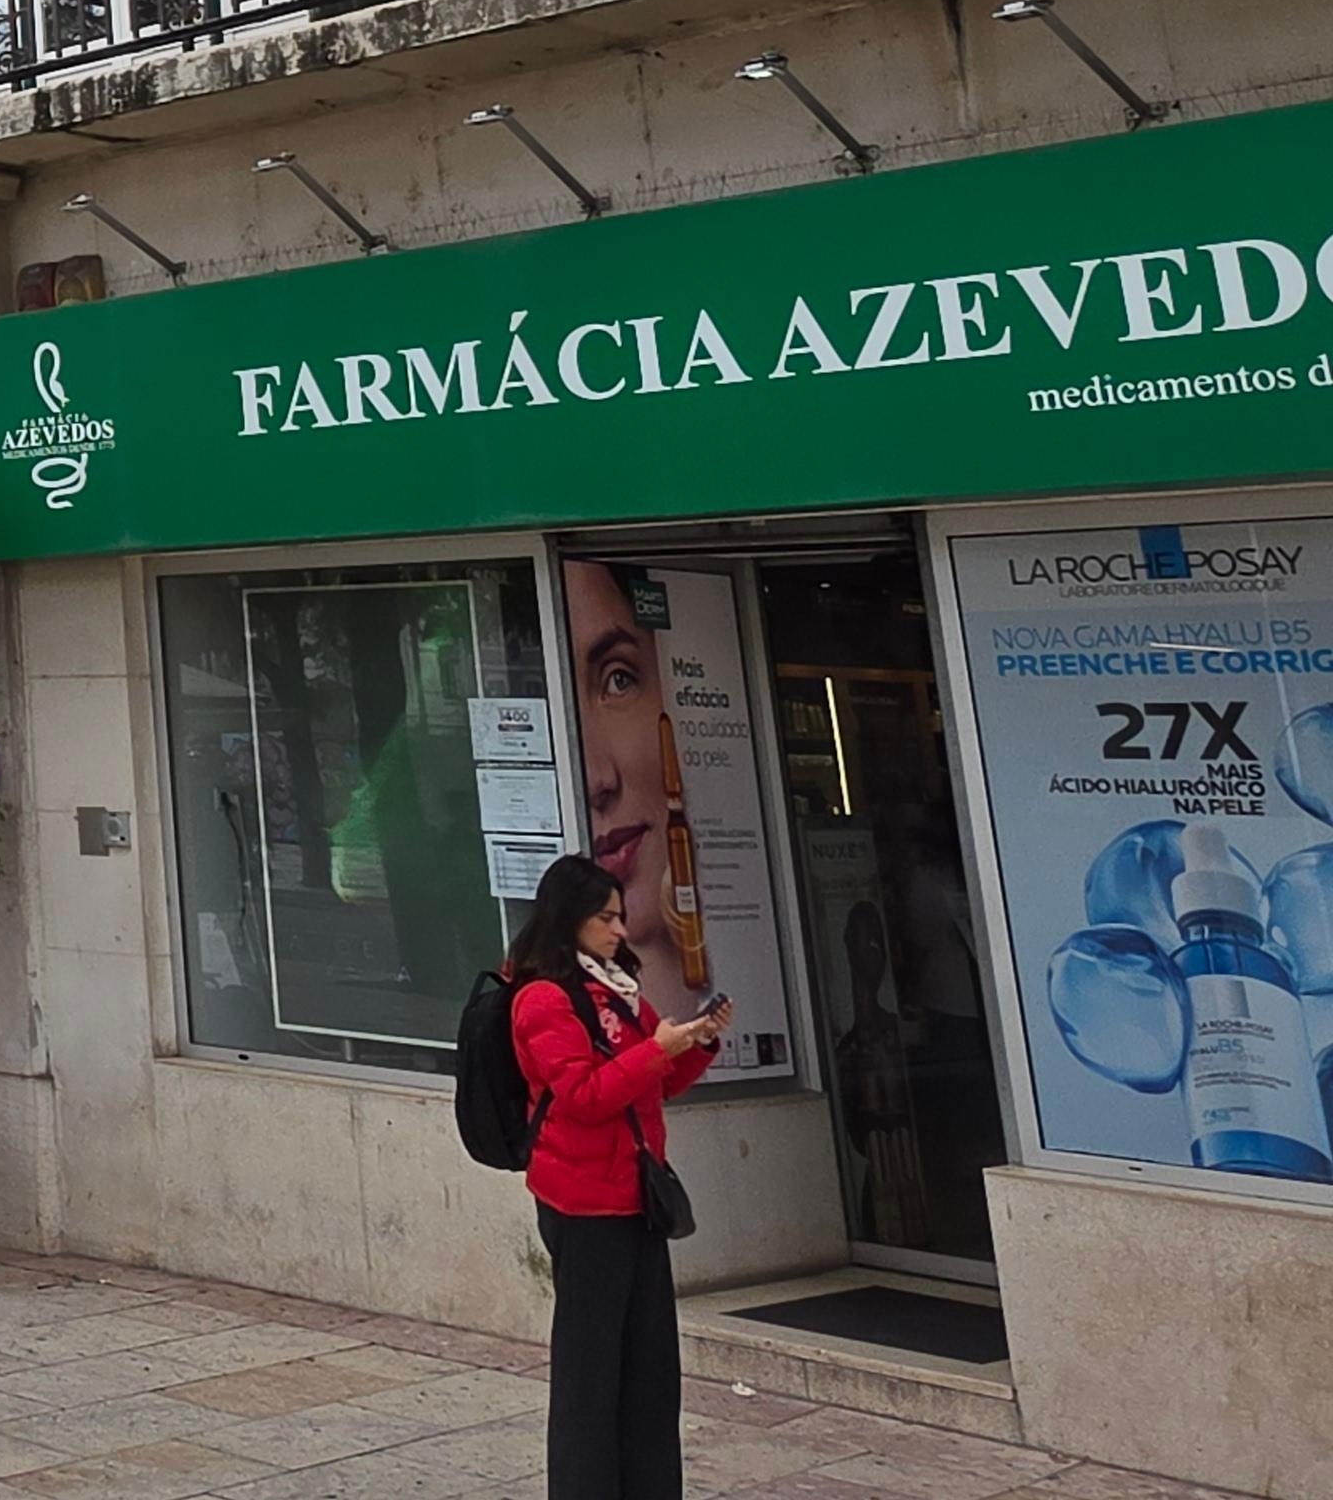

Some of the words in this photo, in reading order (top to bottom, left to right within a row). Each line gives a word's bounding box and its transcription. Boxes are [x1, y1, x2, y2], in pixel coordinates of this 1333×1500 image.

[233, 310, 753, 437] FARMÁCIA
[768, 235, 1333, 380] AZEVED
[1028, 364, 1297, 412] medicamentos
[1, 419, 115, 450] AZEVEDOS
[1008, 558, 1053, 586] LA
[1054, 550, 1175, 584] ROCHE
[1185, 546, 1303, 580] POSAY
[1060, 583, 1152, 598] LABORATOIRE
[1154, 579, 1286, 595] DERMATOLOGIQUE
[991, 627, 1073, 650] NOVA
[1074, 625, 1162, 650] GAMA
[1165, 620, 1264, 649] HYALU
[1270, 619, 1312, 645] B5
[671, 657, 705, 678] Mais
[996, 652, 1170, 677] PREENCHE
[1176, 652, 1196, 674] E
[1201, 648, 1333, 675] CORRIG
[676, 684, 730, 708] eficácia
[1096, 701, 1259, 760] 27X
[1049, 773, 1110, 794] ÁCIDO
[1114, 776, 1266, 798] HIALURÓNICO
[1206, 763, 1263, 781] MAIS
[1173, 798, 1207, 815] NA
[1210, 799, 1265, 817] PELE
